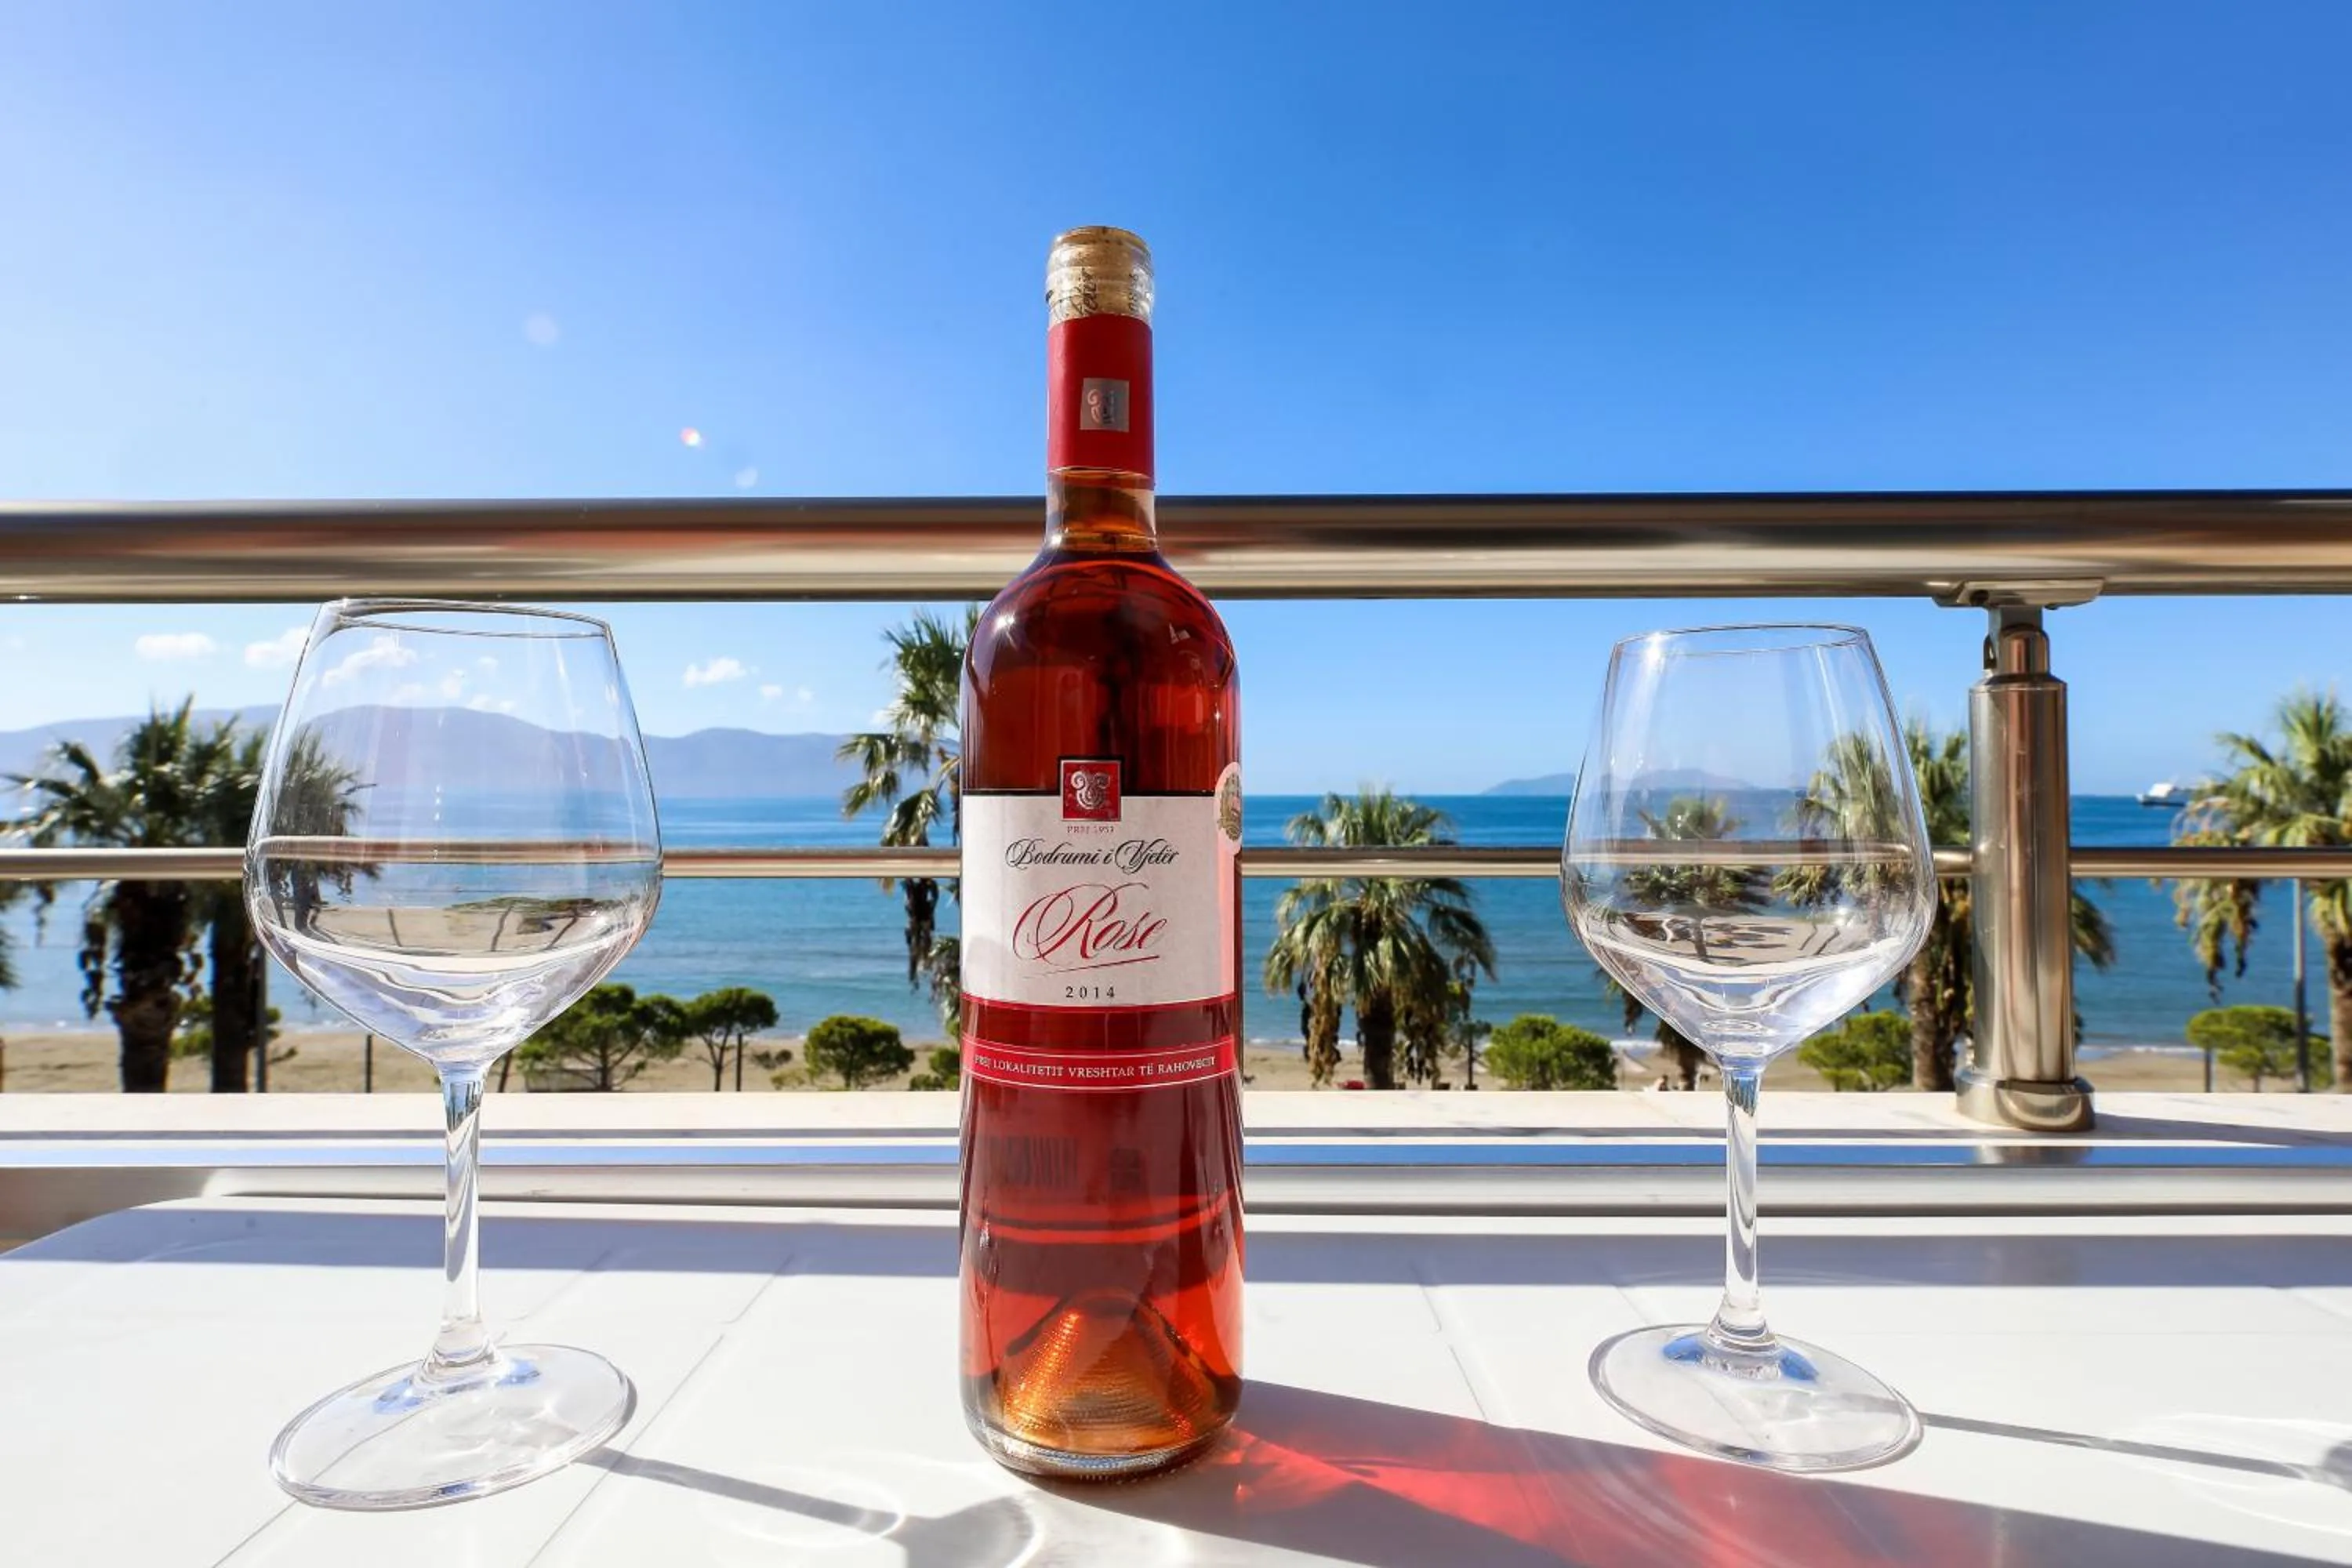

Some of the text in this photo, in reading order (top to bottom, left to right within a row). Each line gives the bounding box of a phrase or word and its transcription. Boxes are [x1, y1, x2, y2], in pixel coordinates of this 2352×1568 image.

[1005, 838, 1102, 870] Bodrumi
[1103, 849, 1114, 865] i
[1012, 882, 1167, 969] Rose
[1065, 985, 1116, 999] 2014
[993, 1059, 1064, 1077] LOKALITETIT
[1068, 1066, 1134, 1079] VRESHTAR
[1140, 1063, 1153, 1076] TË
